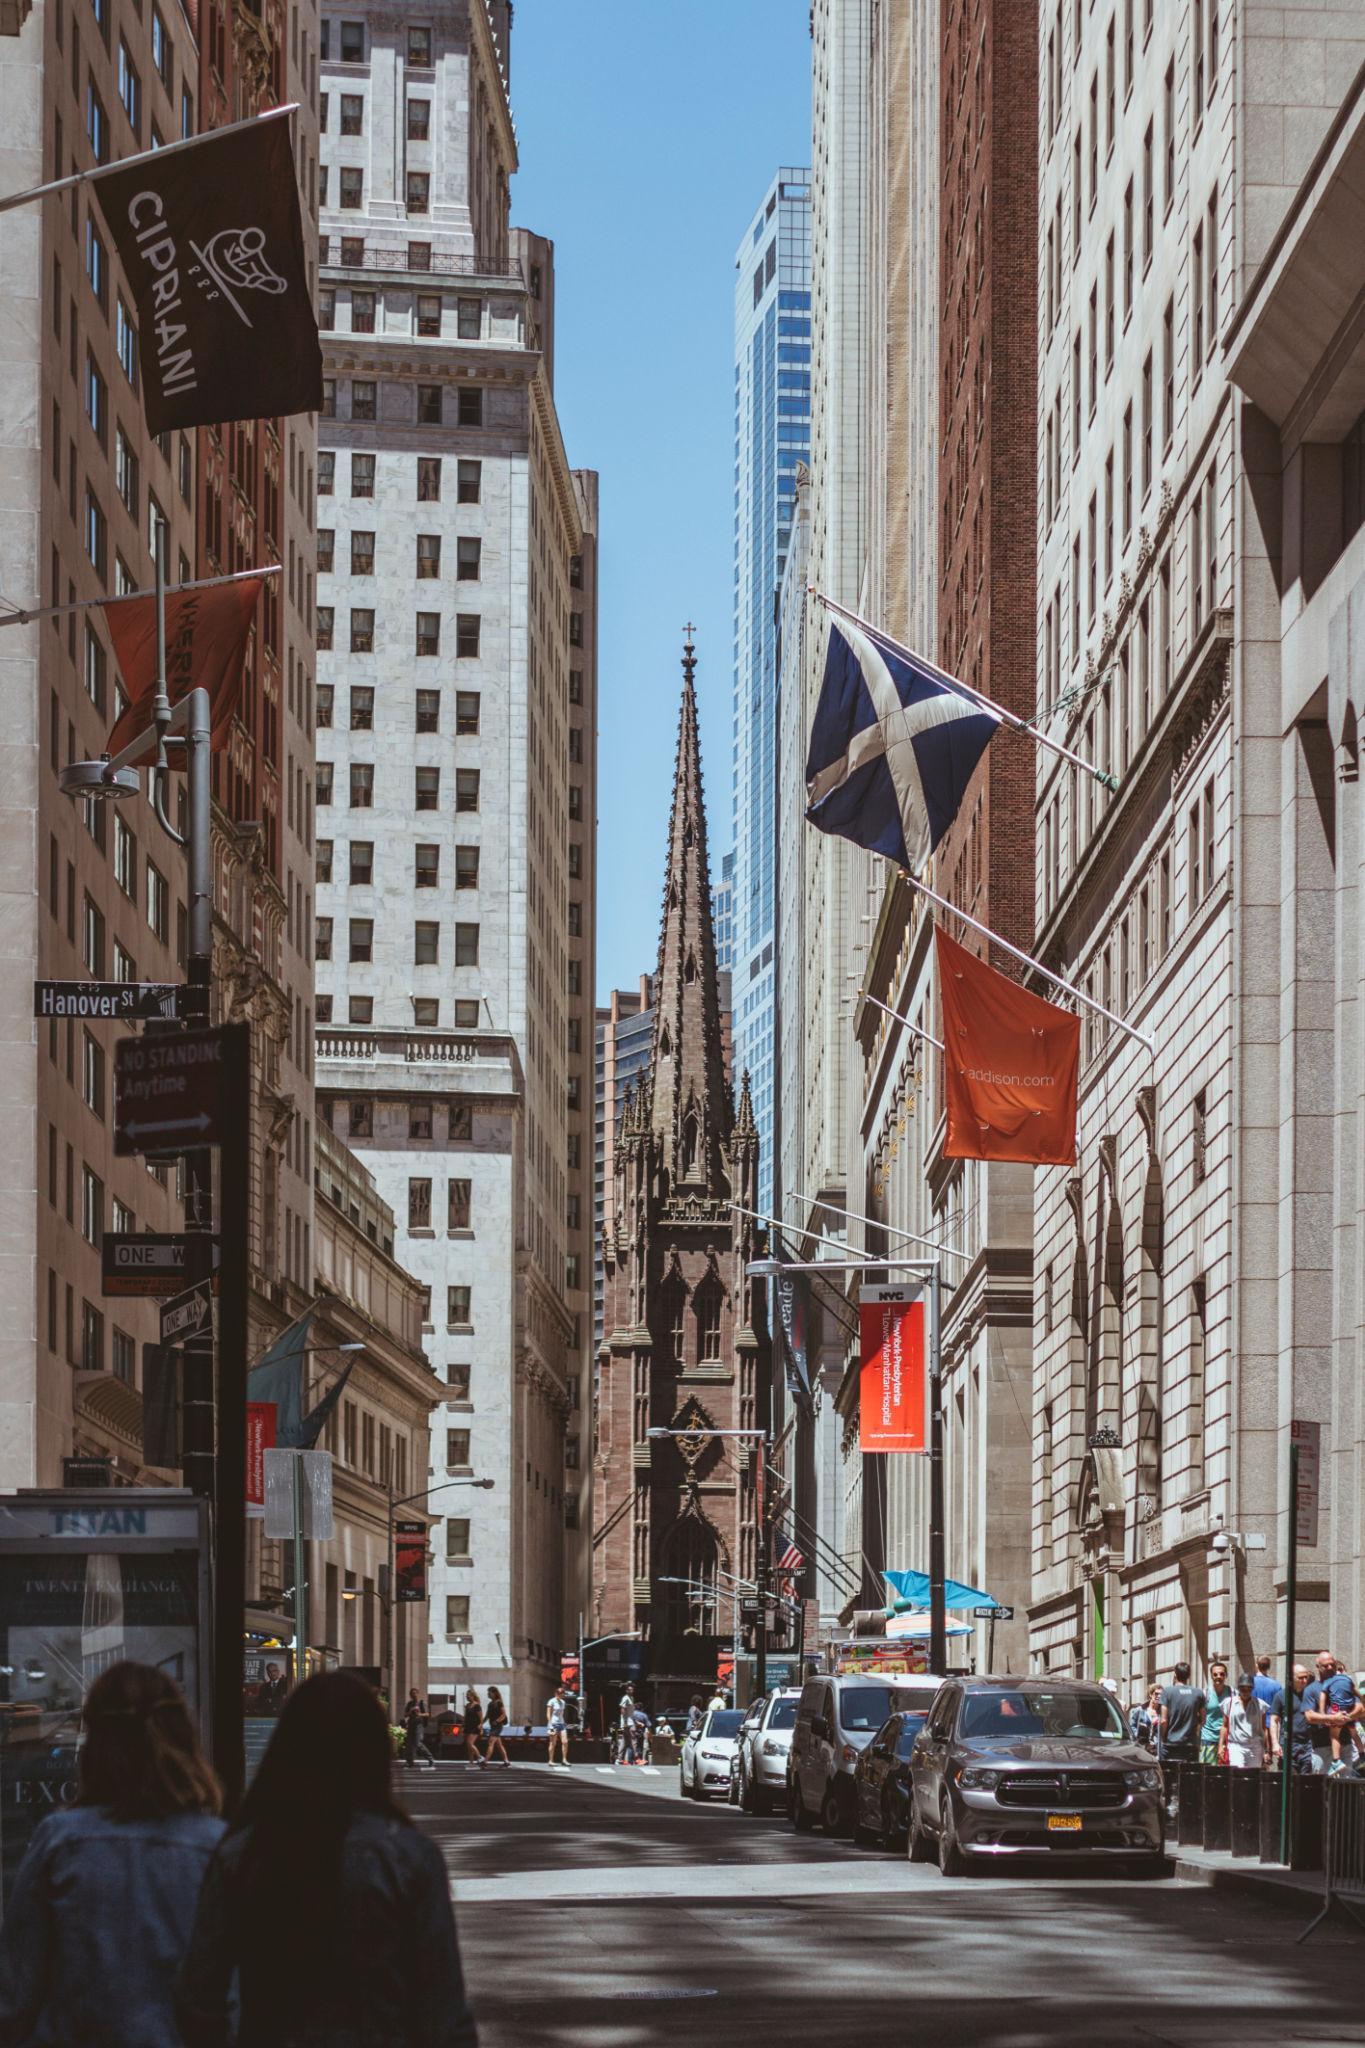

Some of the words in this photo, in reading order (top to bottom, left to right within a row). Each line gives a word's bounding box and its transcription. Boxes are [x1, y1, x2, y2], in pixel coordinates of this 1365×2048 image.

[128, 190, 198, 397] CIPRIANI
[41, 988, 119, 1016] Hanover
[121, 990, 134, 1007] St
[123, 1050, 146, 1071] NO
[123, 1073, 188, 1099] Anytime
[968, 1068, 1055, 1087] addison.com
[118, 1247, 155, 1264] ONE
[879, 1290, 904, 1301] NYC
[166, 1312, 180, 1333] ONE
[186, 1301, 202, 1323] WAY
[882, 1316, 891, 1342] Lower
[883, 1344, 891, 1390] Manhattan
[881, 1392, 892, 1426] Hospital
[49, 1507, 147, 1534] TITAN
[24, 1579, 90, 1594] TWENTY
[95, 1578, 182, 1594] EXCHANGE
